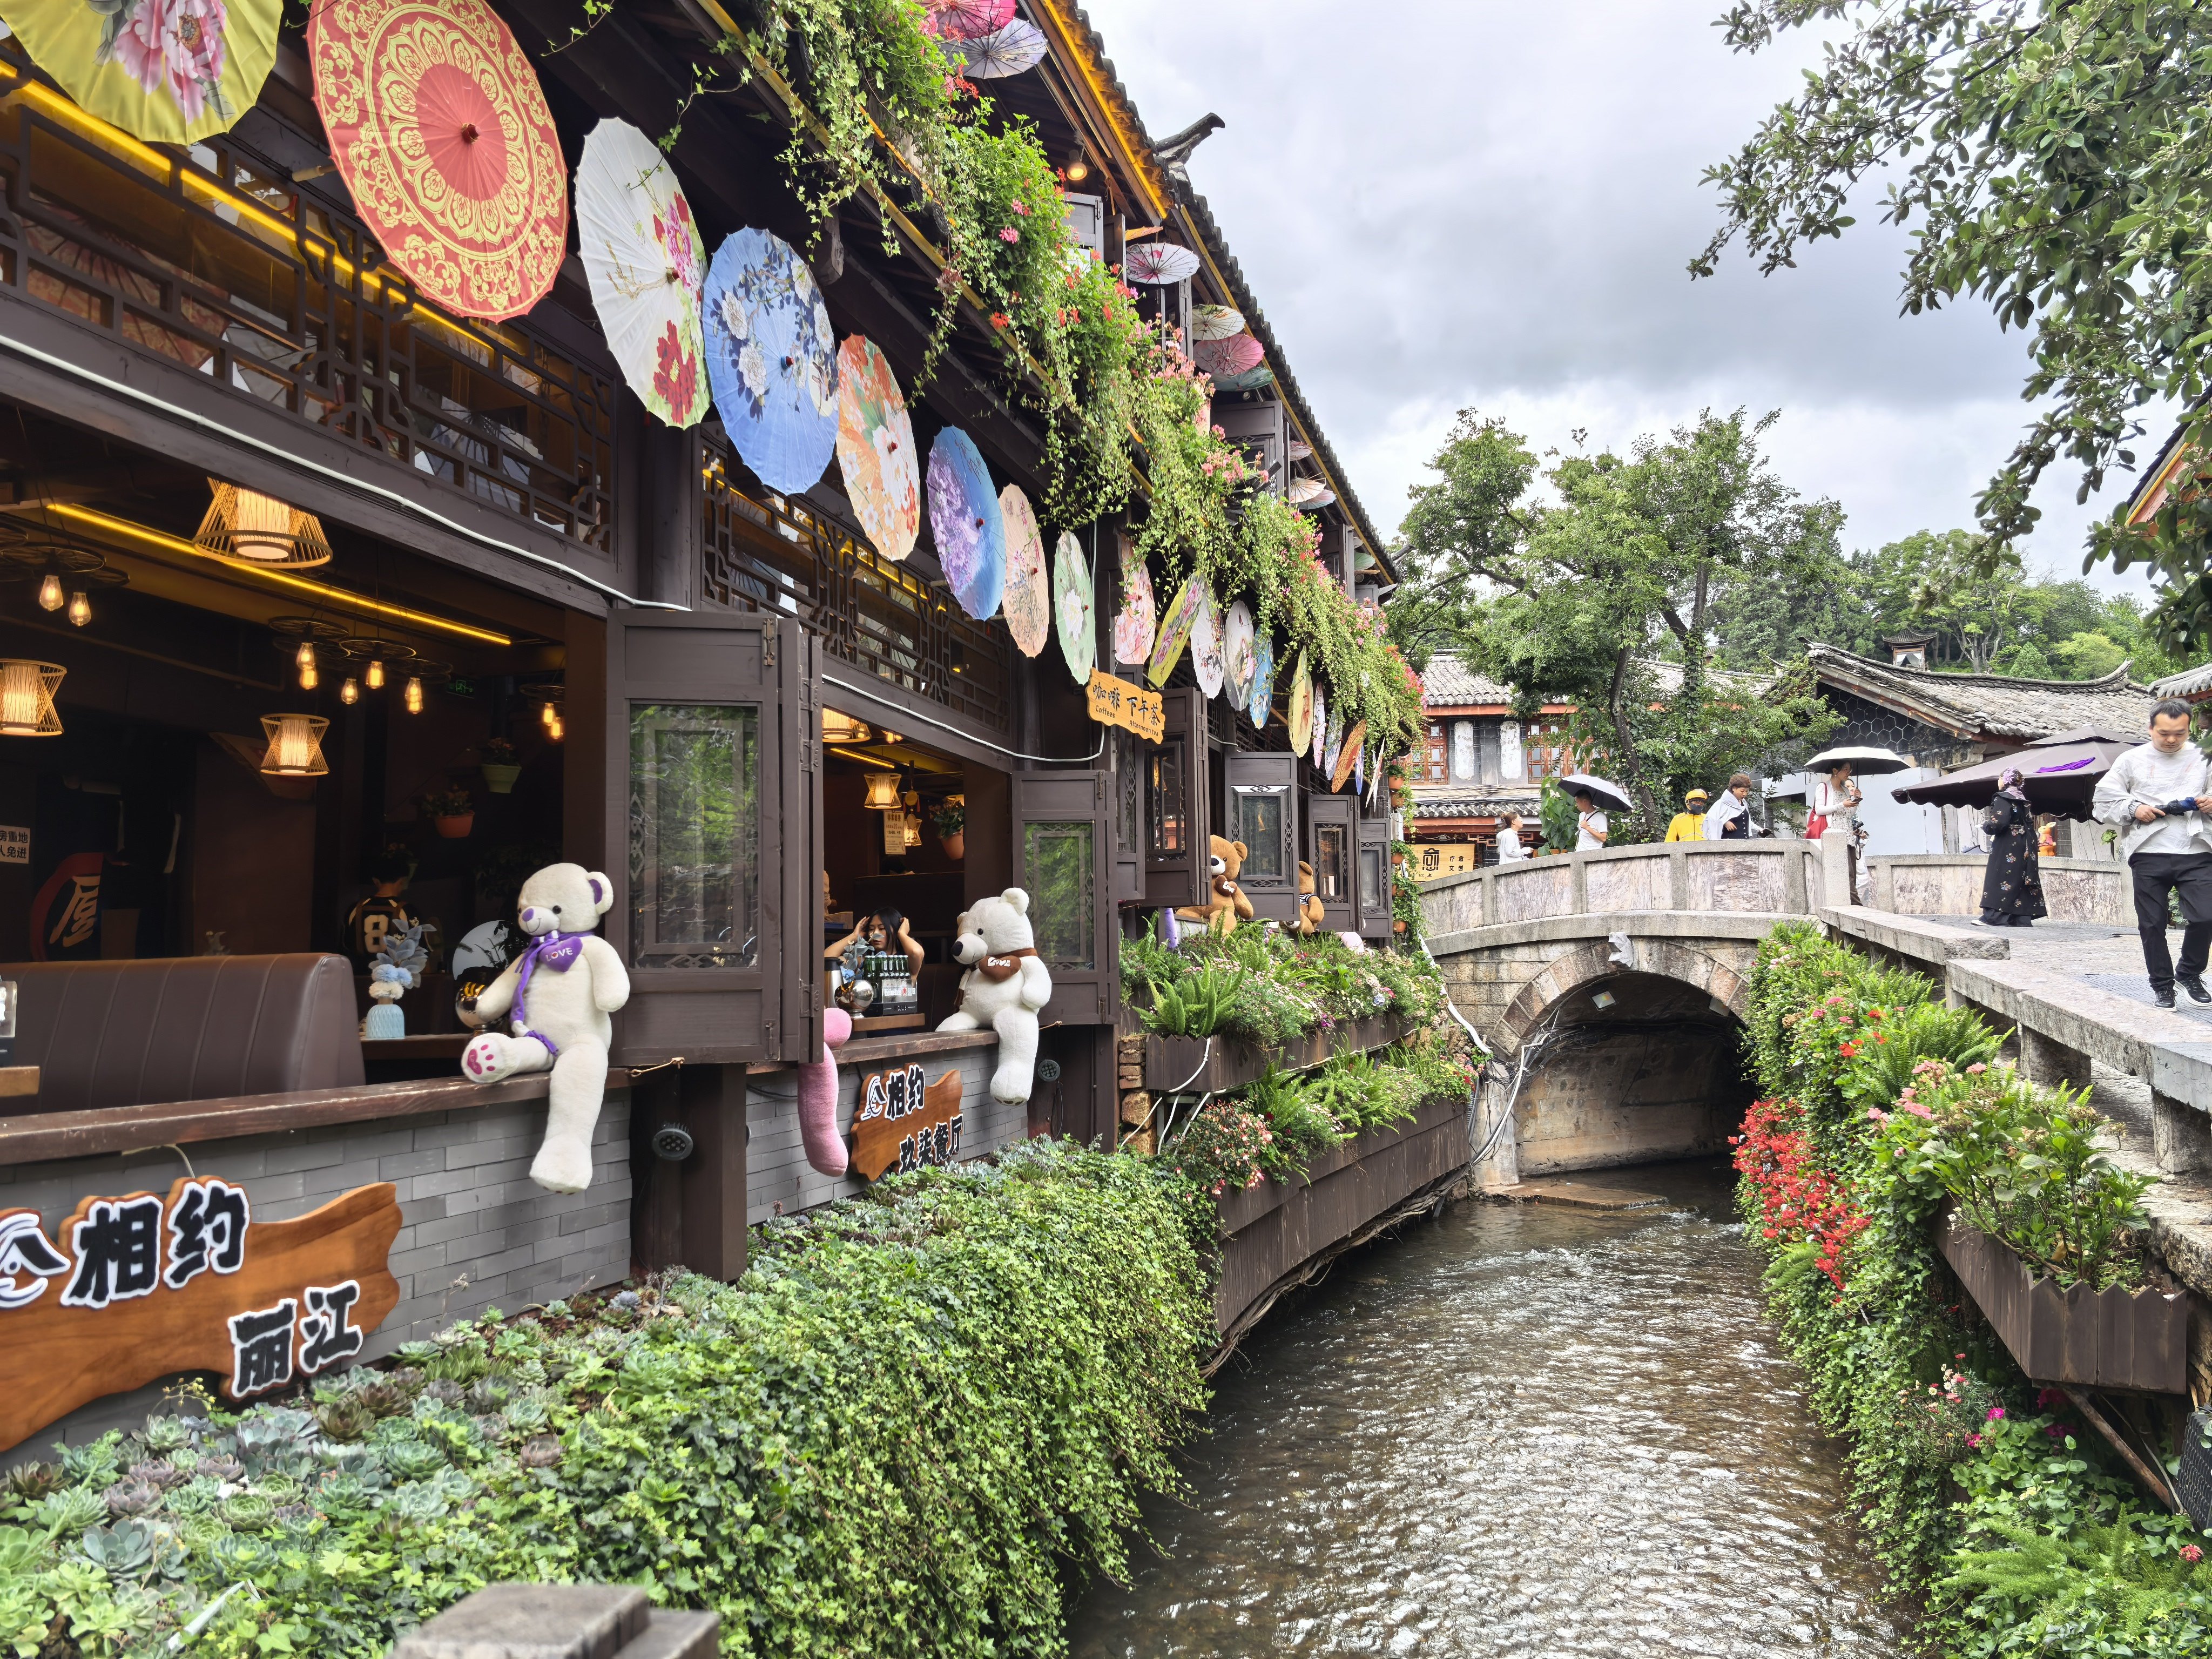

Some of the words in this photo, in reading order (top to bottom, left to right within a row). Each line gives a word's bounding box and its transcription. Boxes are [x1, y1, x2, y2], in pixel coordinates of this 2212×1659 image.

[1092, 682, 1121, 712] 咖啡
[1126, 696, 1161, 726] 下午茶
[1095, 705, 1115, 718] Coffees
[1129, 720, 1151, 733] Afternoon
[364, 914, 389, 953] 8
[545, 947, 573, 962] LOVE
[899, 1114, 963, 1175] 玖柒餐厅
[228, 1280, 363, 1398] 丽江
